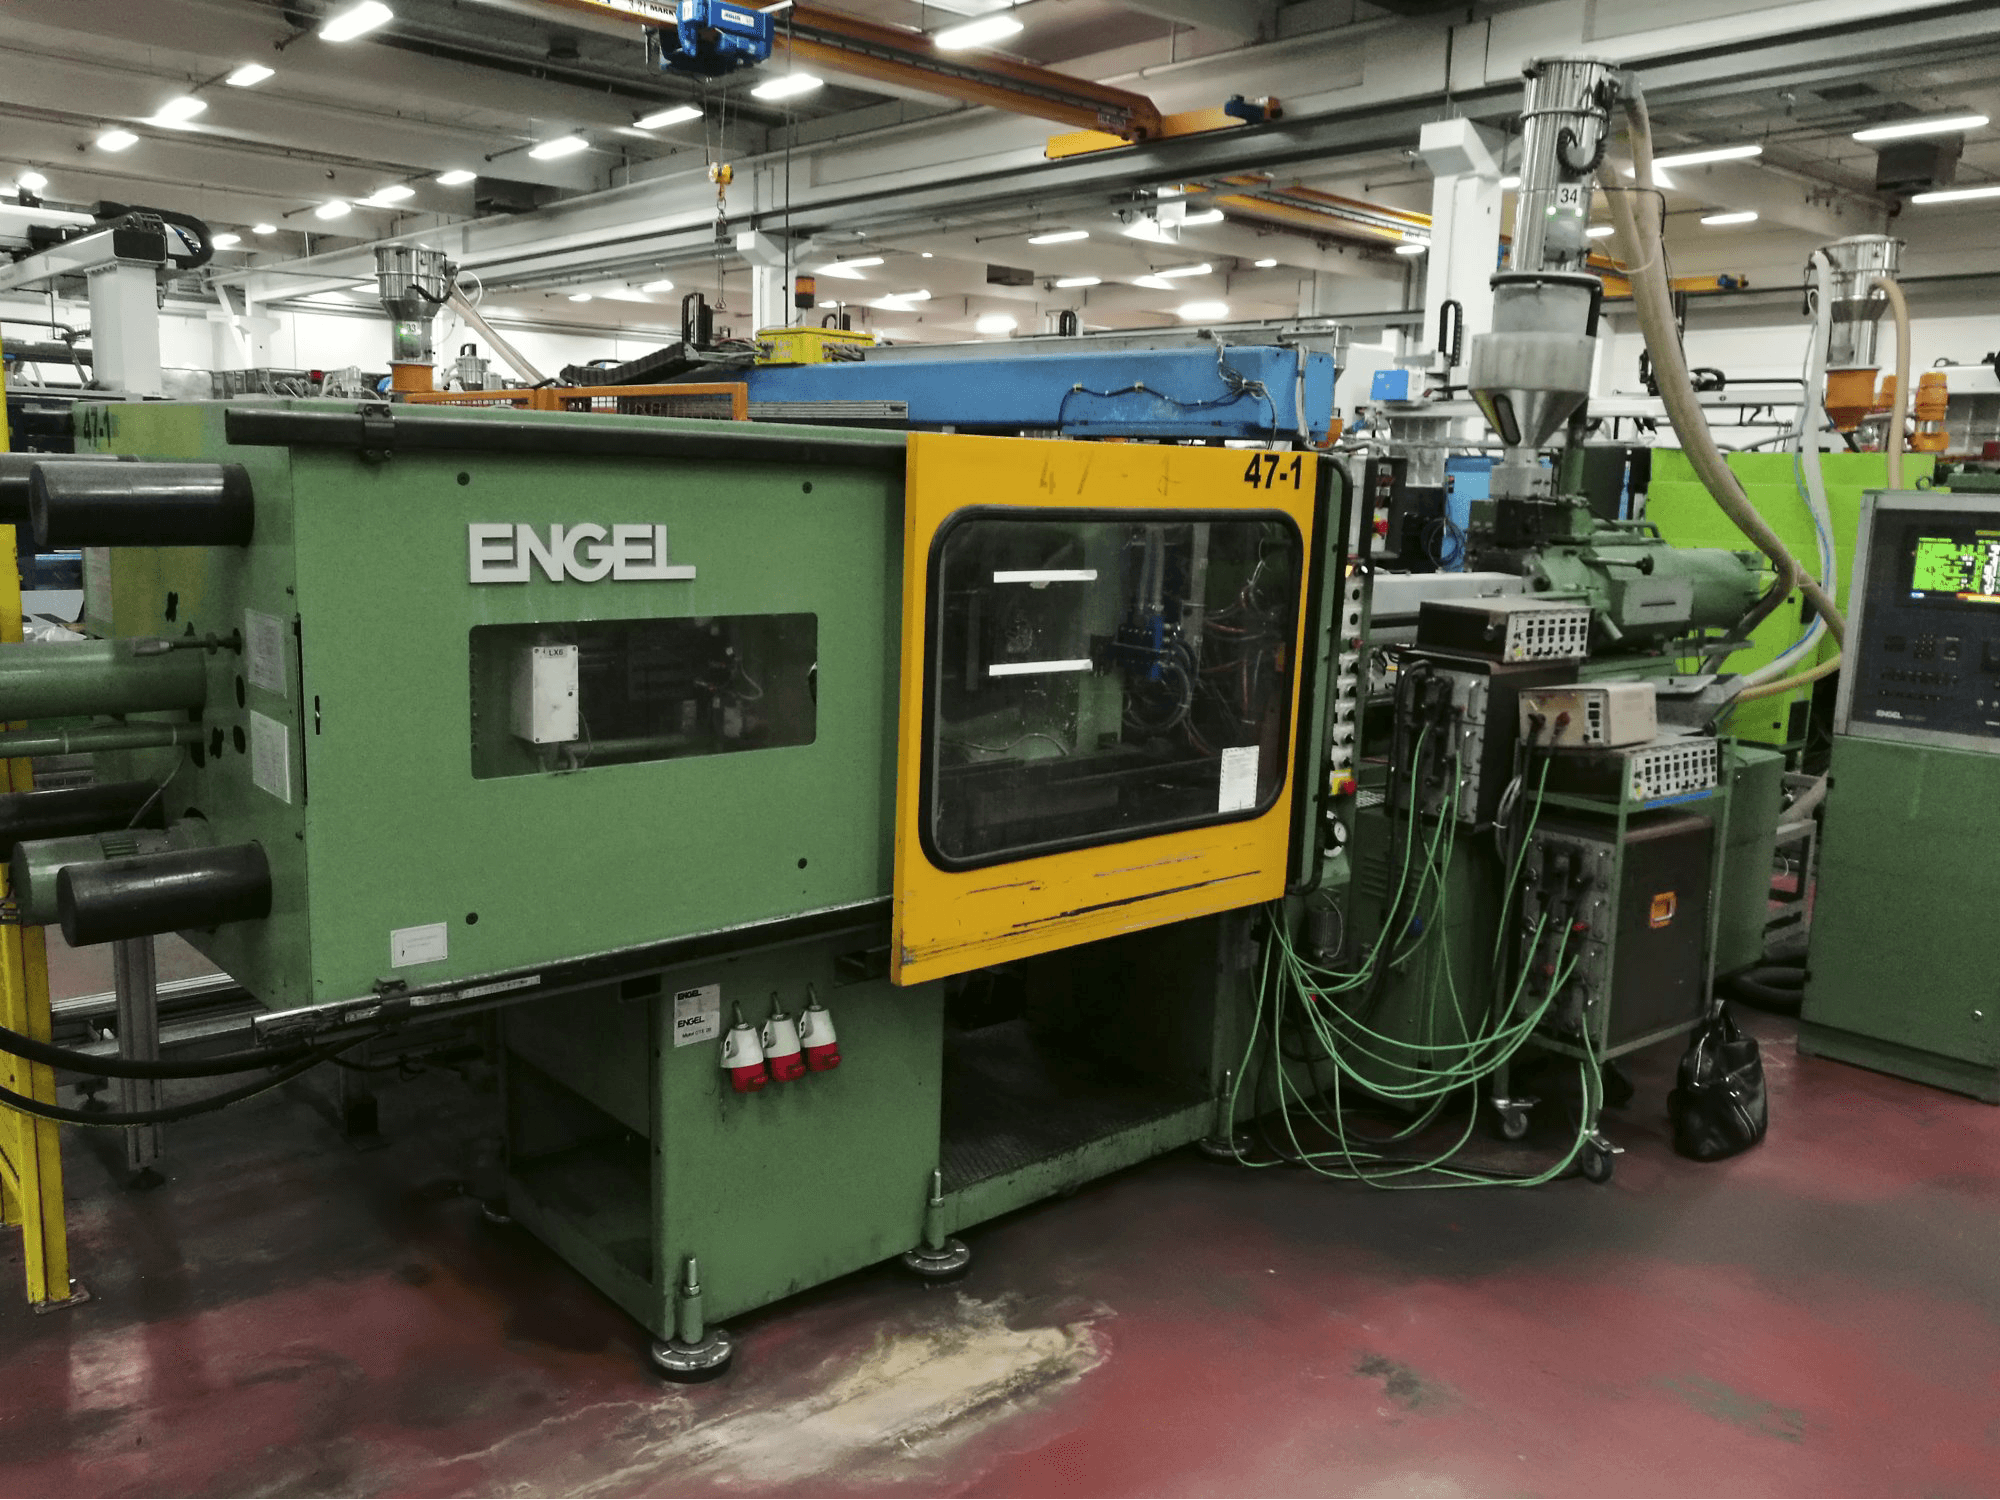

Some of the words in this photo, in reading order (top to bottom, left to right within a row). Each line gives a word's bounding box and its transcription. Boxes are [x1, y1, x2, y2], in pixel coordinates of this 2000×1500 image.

[1560, 188, 1577, 203] 34
[1244, 453, 1302, 490] 47-1
[469, 522, 697, 584] ENGEL
[677, 989, 702, 1000] ENGEL
[677, 1016, 705, 1028] ENGEL
